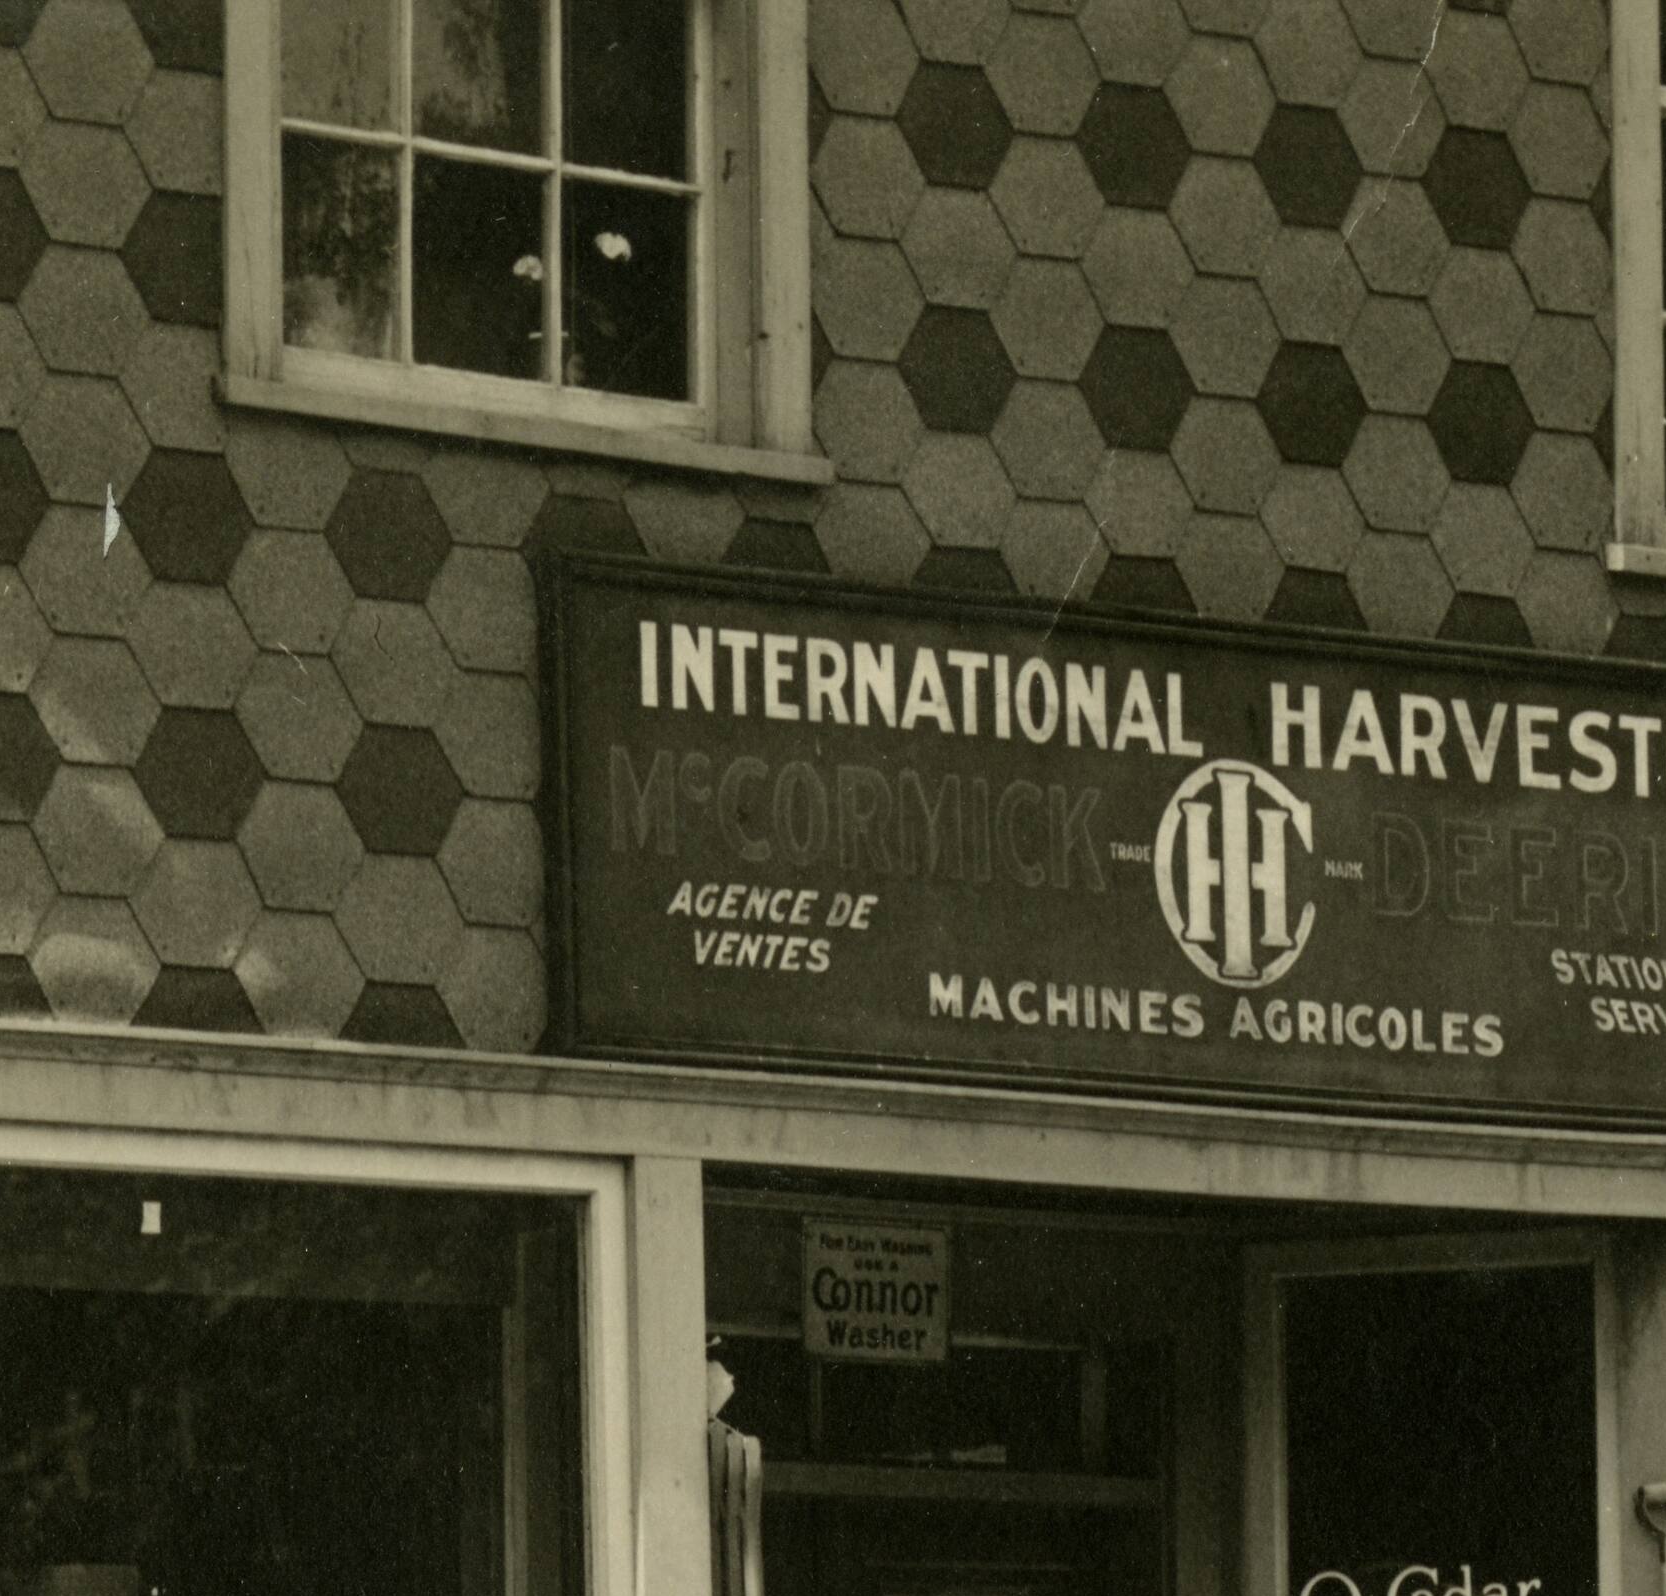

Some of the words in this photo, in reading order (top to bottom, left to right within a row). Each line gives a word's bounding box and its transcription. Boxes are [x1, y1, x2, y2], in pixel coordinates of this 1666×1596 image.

[639, 621, 1203, 757] INTERNATIONAL
[1110, 842, 1151, 863] TRADE
[1325, 860, 1364, 880] MARK
[667, 881, 812, 926] AGENCE
[826, 893, 879, 930] DE
[693, 930, 832, 974] VENTES
[928, 972, 1204, 1039] MACHINES
[1229, 996, 1505, 1059] AGRICOLES
[812, 1266, 939, 1317] Connor
[826, 1320, 927, 1352] Washer
